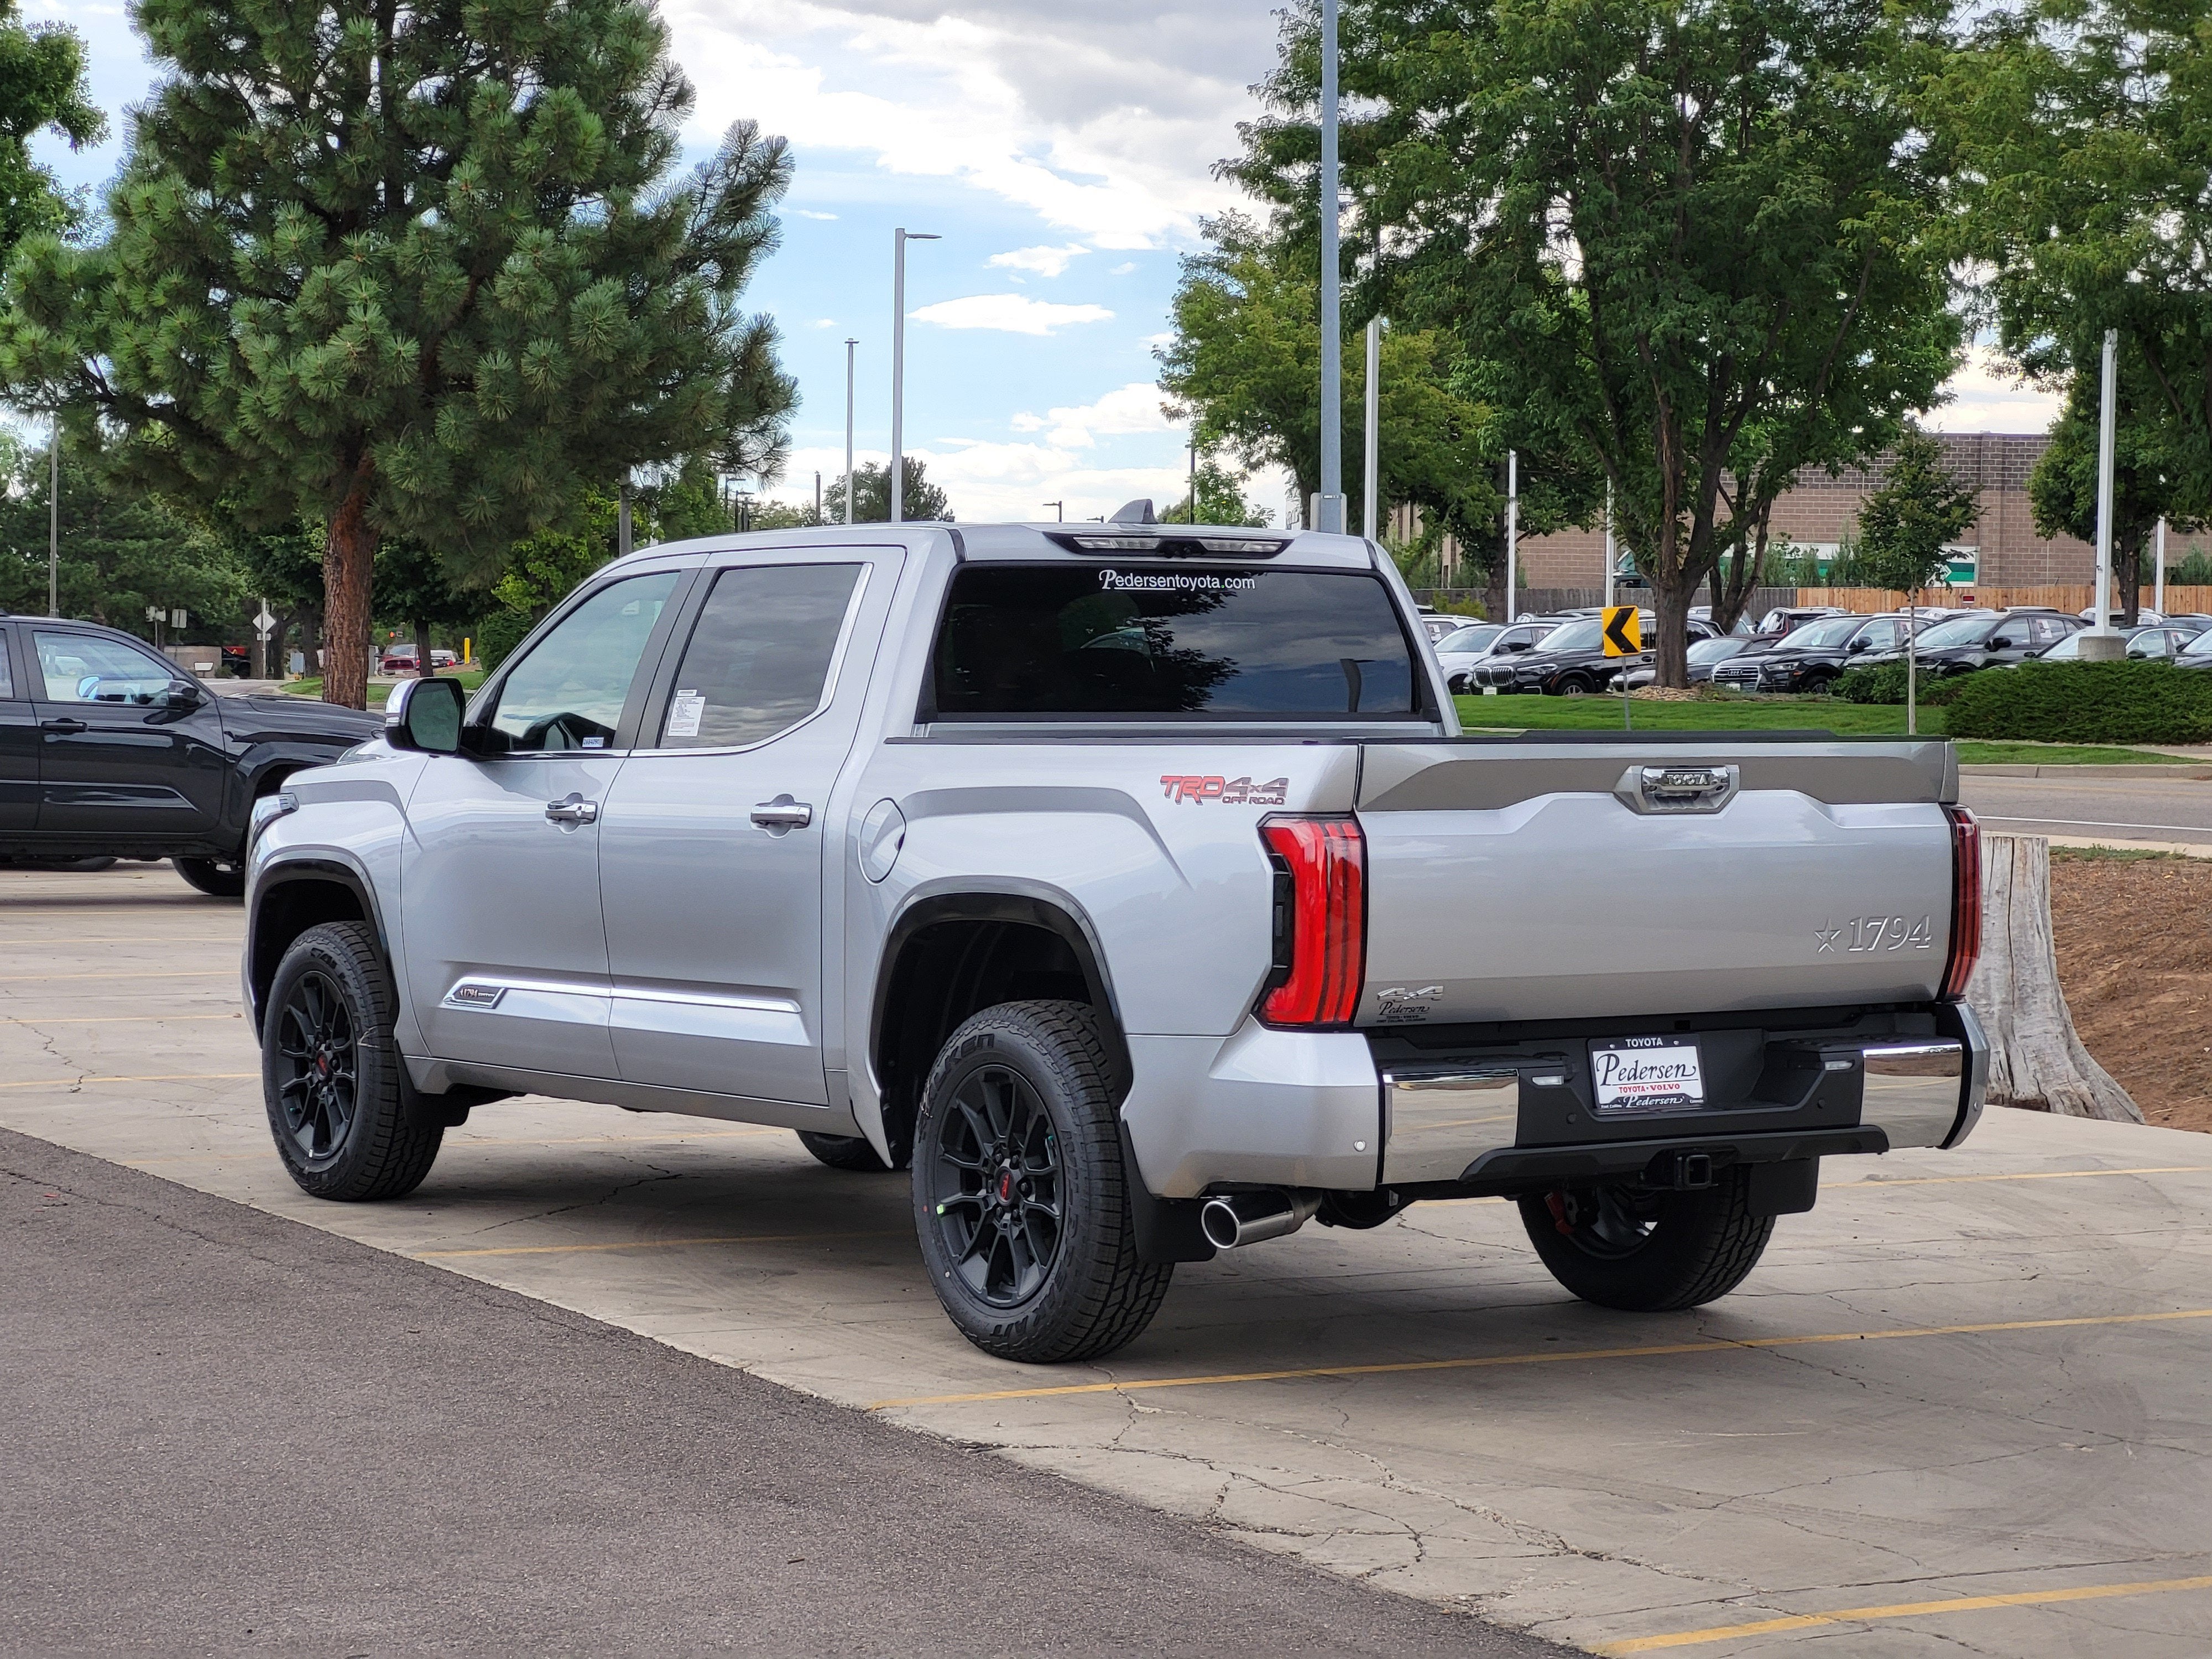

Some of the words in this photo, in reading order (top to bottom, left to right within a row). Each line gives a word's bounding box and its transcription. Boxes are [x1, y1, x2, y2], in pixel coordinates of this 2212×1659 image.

[1098, 569, 1255, 591] Pedersentoyota.com
[1666, 774, 1708, 785] TOYOTA
[1160, 775, 1226, 805] TRD
[1225, 776, 1289, 797] 4x4
[1249, 797, 1286, 805] ROAD
[1848, 915, 1932, 951] 1794
[1379, 1001, 1430, 1015] Pedersen
[1625, 1037, 1663, 1047] TOYOTA
[1596, 1053, 1697, 1086] Pedersen
[1623, 1095, 1683, 1108] Pedersen
